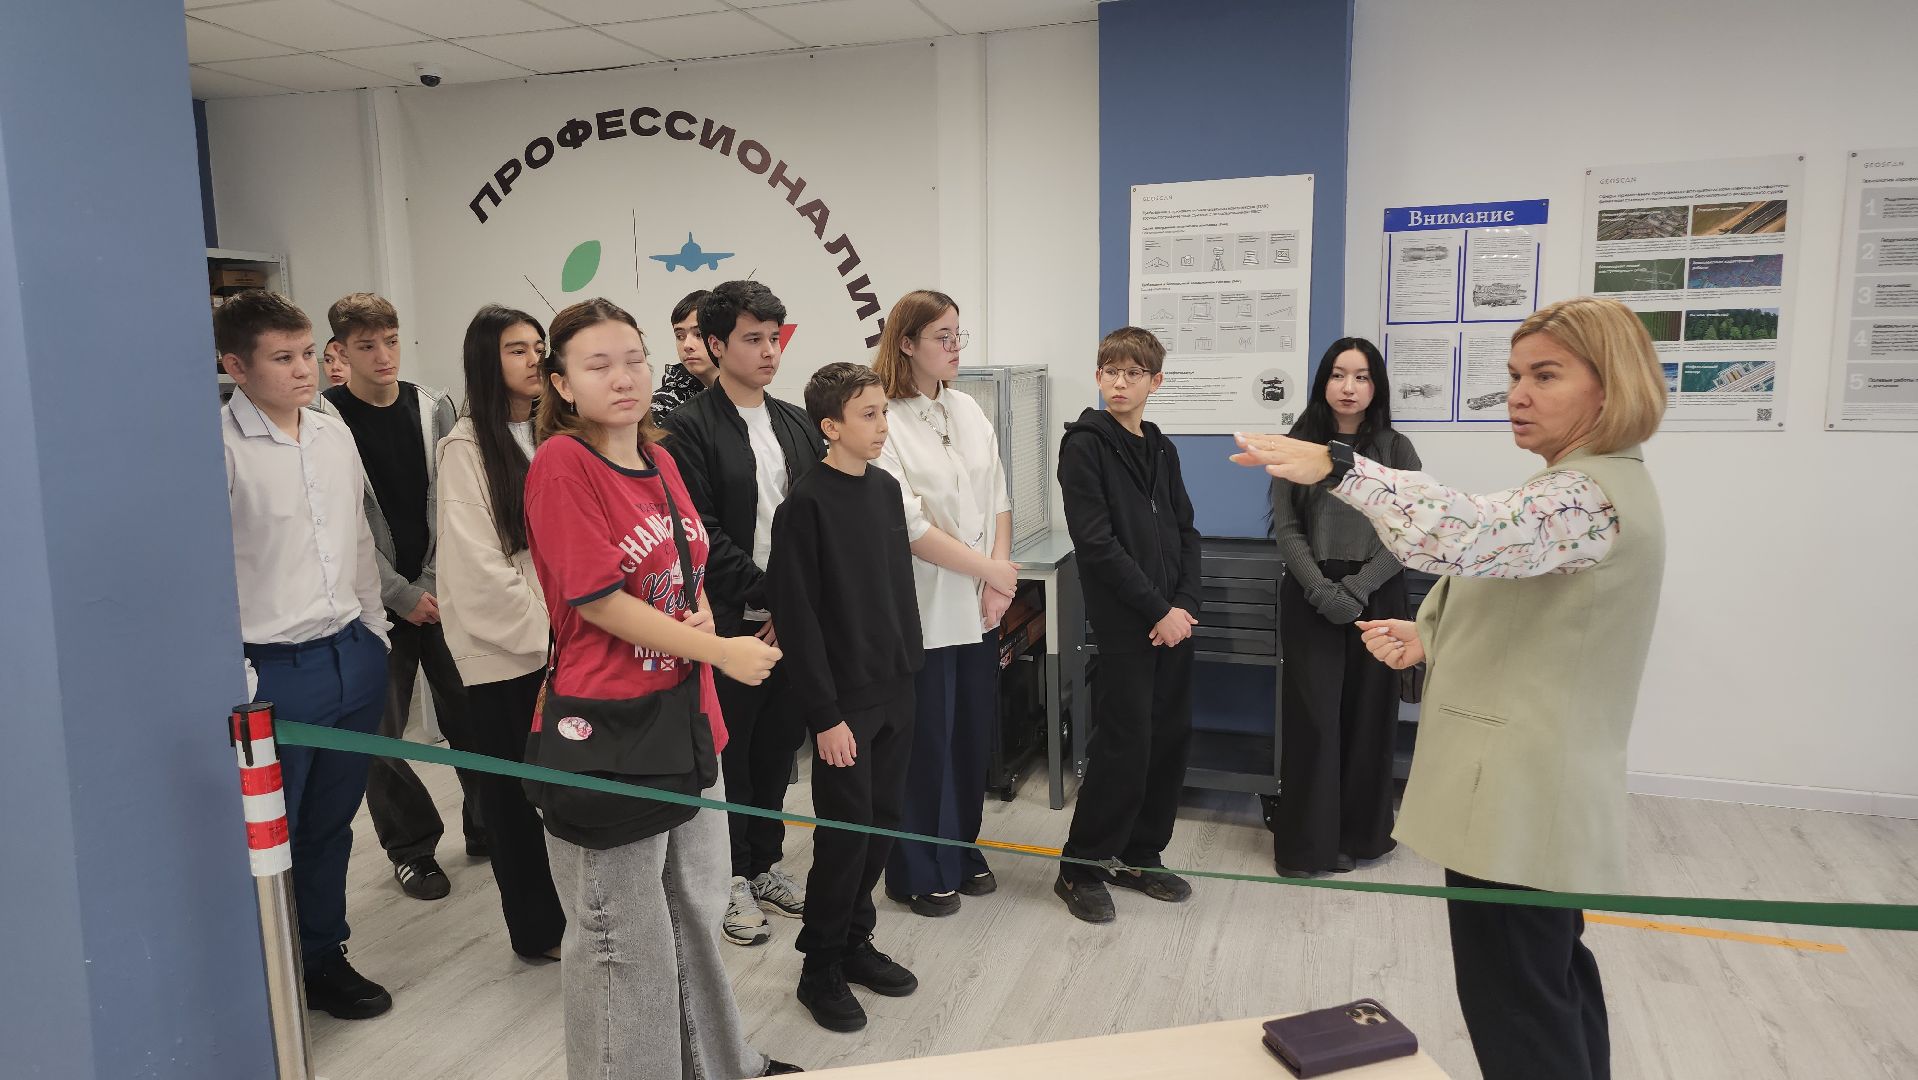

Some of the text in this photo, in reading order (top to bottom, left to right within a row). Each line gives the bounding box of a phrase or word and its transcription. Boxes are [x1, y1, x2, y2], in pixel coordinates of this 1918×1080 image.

[1599, 176, 1638, 185] GEOSCAN
[1865, 199, 1876, 216] 1
[1407, 209, 1516, 227] Внимание
[469, 106, 886, 349] ПРОФЕССИОНАЛИТ
[1862, 243, 1875, 260] 2
[1858, 286, 1871, 304] 3
[1854, 330, 1867, 347] 4
[1849, 373, 1864, 390] 5
